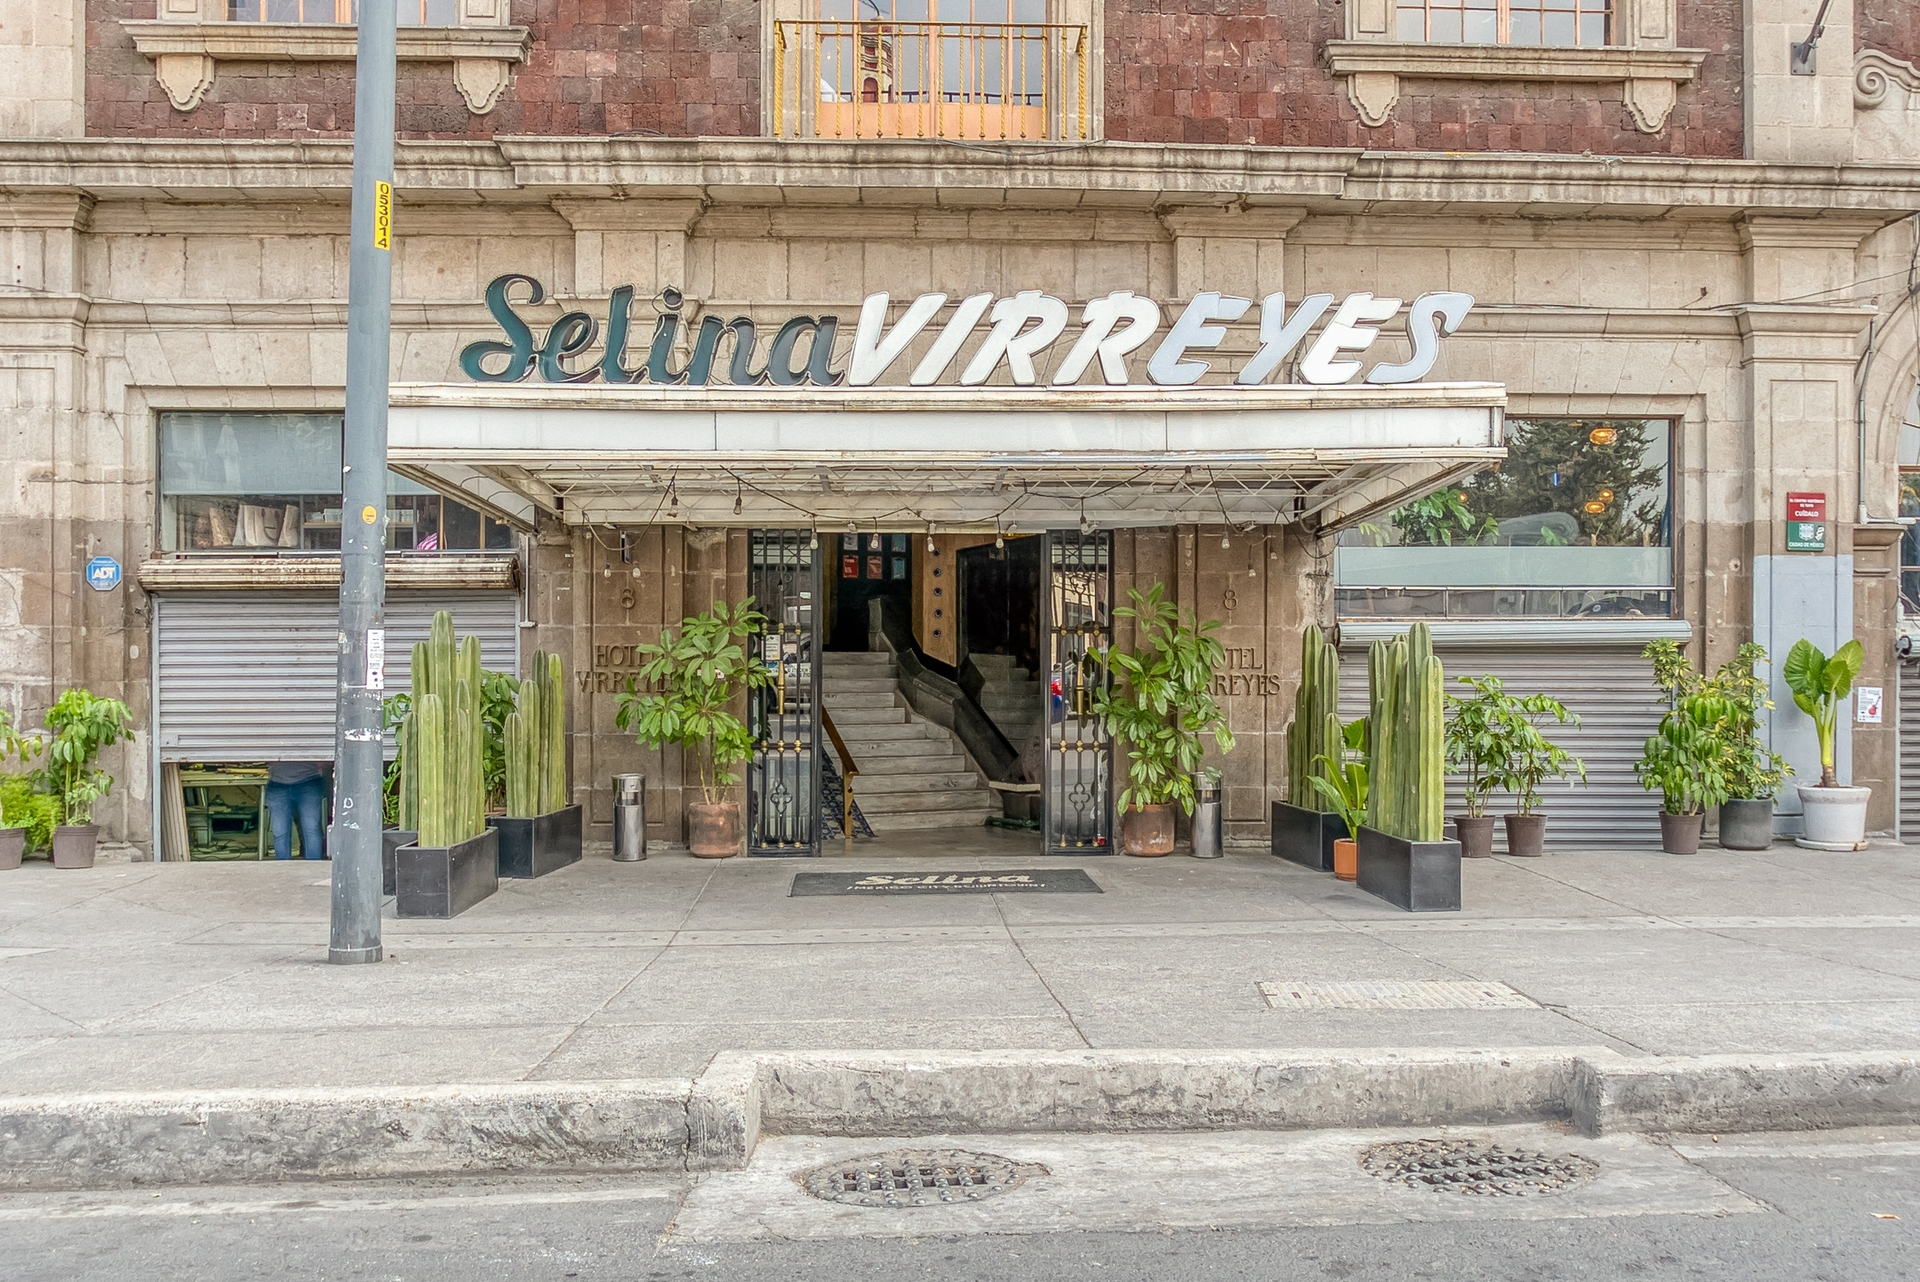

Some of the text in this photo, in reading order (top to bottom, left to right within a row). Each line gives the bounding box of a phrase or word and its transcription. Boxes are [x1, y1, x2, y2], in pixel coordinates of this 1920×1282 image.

[378, 183, 389, 248] 053014
[459, 273, 1475, 386] Selina VIRREYES
[92, 567, 116, 579] ADT
[621, 588, 635, 609] 8
[1223, 590, 1237, 610] 8
